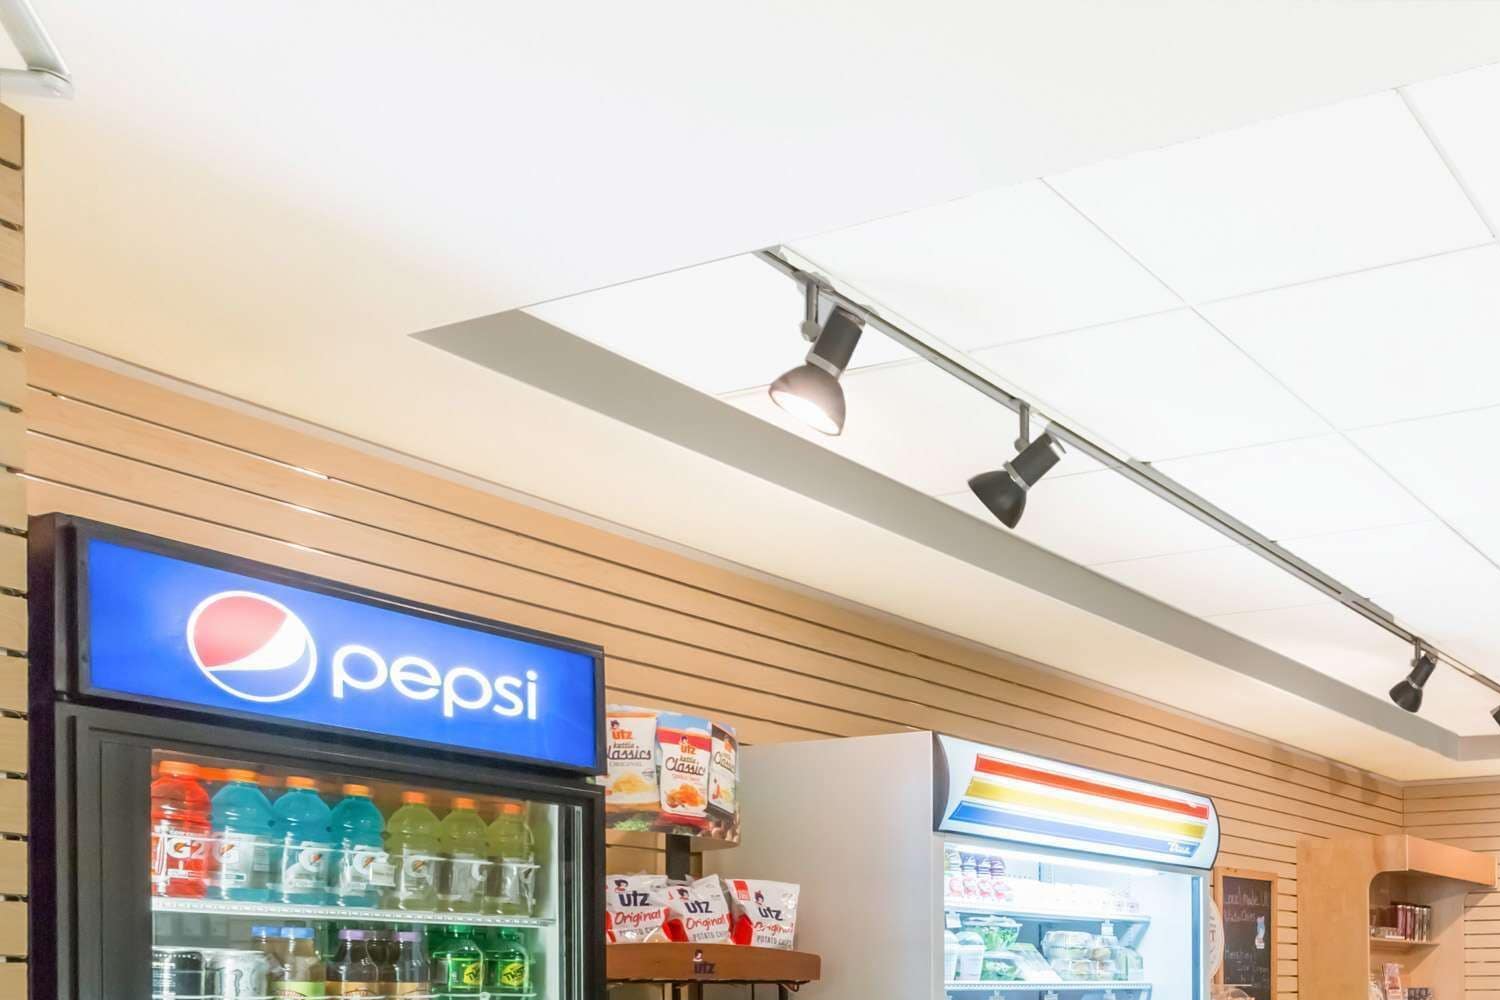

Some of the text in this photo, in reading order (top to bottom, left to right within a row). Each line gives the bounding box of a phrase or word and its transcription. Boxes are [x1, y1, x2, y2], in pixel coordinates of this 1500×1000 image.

[331, 643, 538, 720] pepsi
[607, 745, 652, 760] lassics
[619, 890, 650, 907] utz
[684, 900, 713, 914] utz
[759, 906, 784, 921] utz
[614, 910, 662, 928] Original
[686, 915, 727, 931] Original
